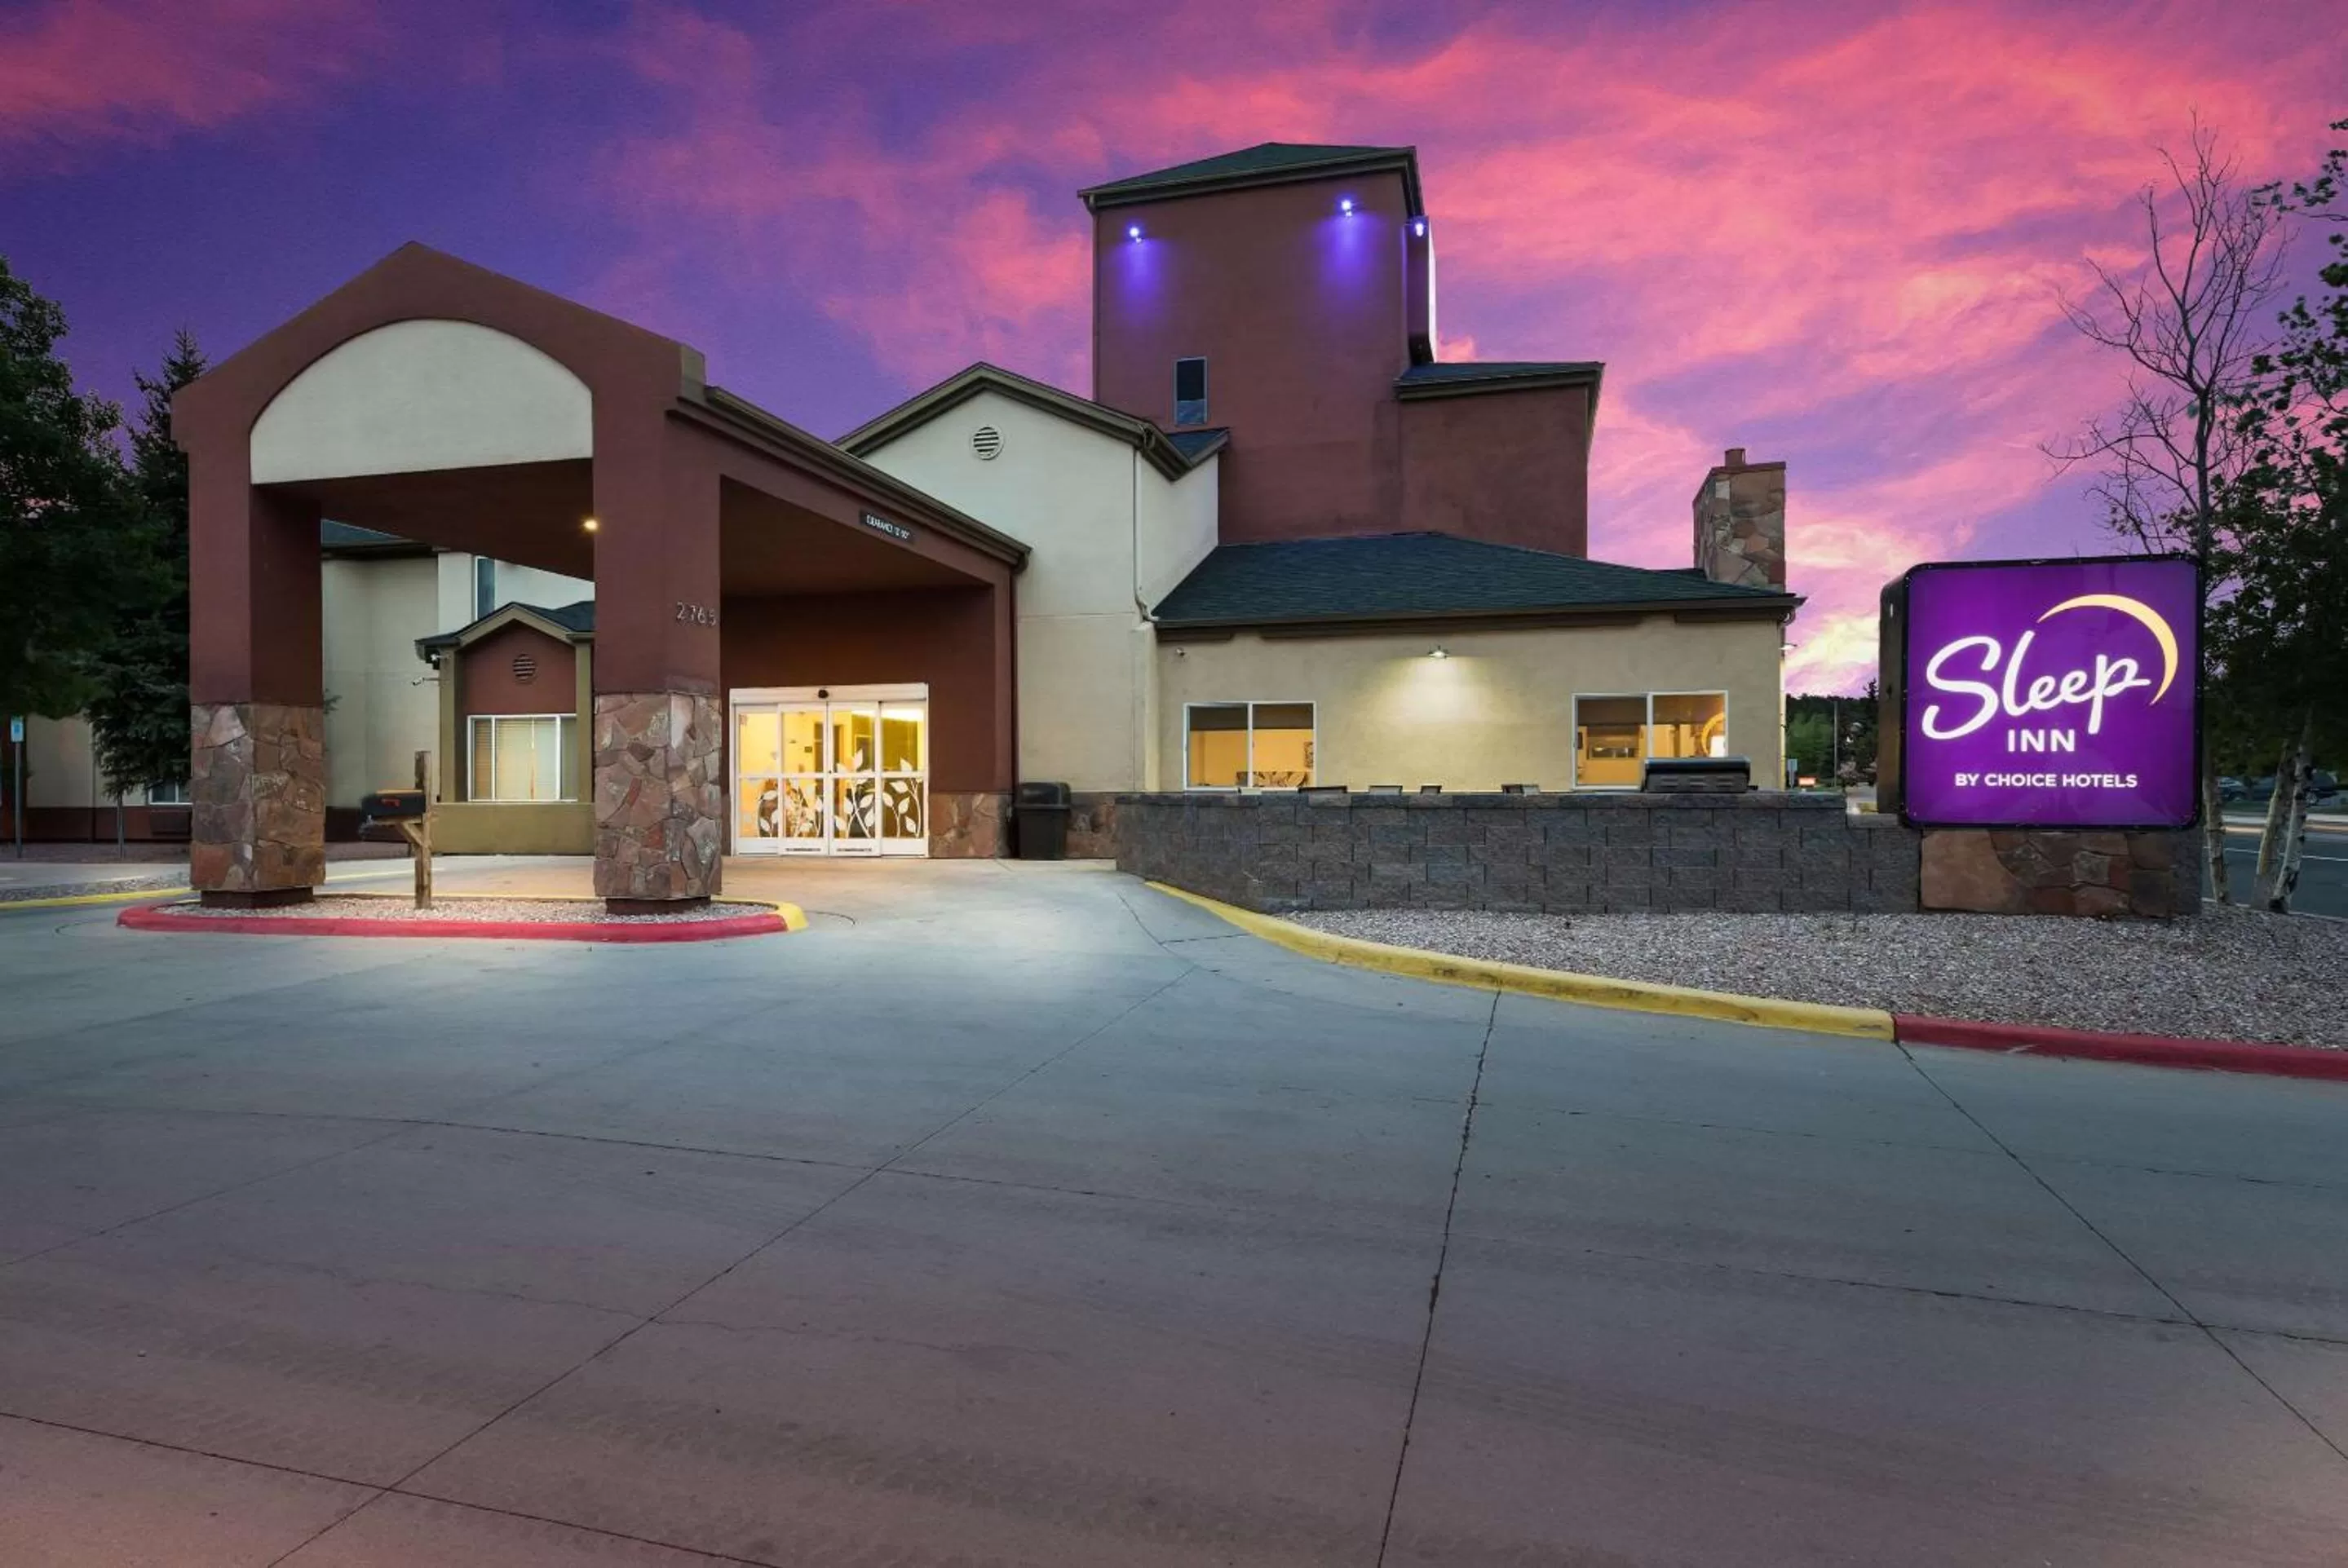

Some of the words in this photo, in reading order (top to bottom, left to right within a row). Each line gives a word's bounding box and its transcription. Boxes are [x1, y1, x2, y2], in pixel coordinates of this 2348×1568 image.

[1921, 630, 2151, 739] Sleep
[2008, 729, 2075, 752] INN
[1955, 773, 1979, 787] BY
[1984, 773, 2057, 787] CHOICE
[2063, 774, 2138, 788] HOTELS
